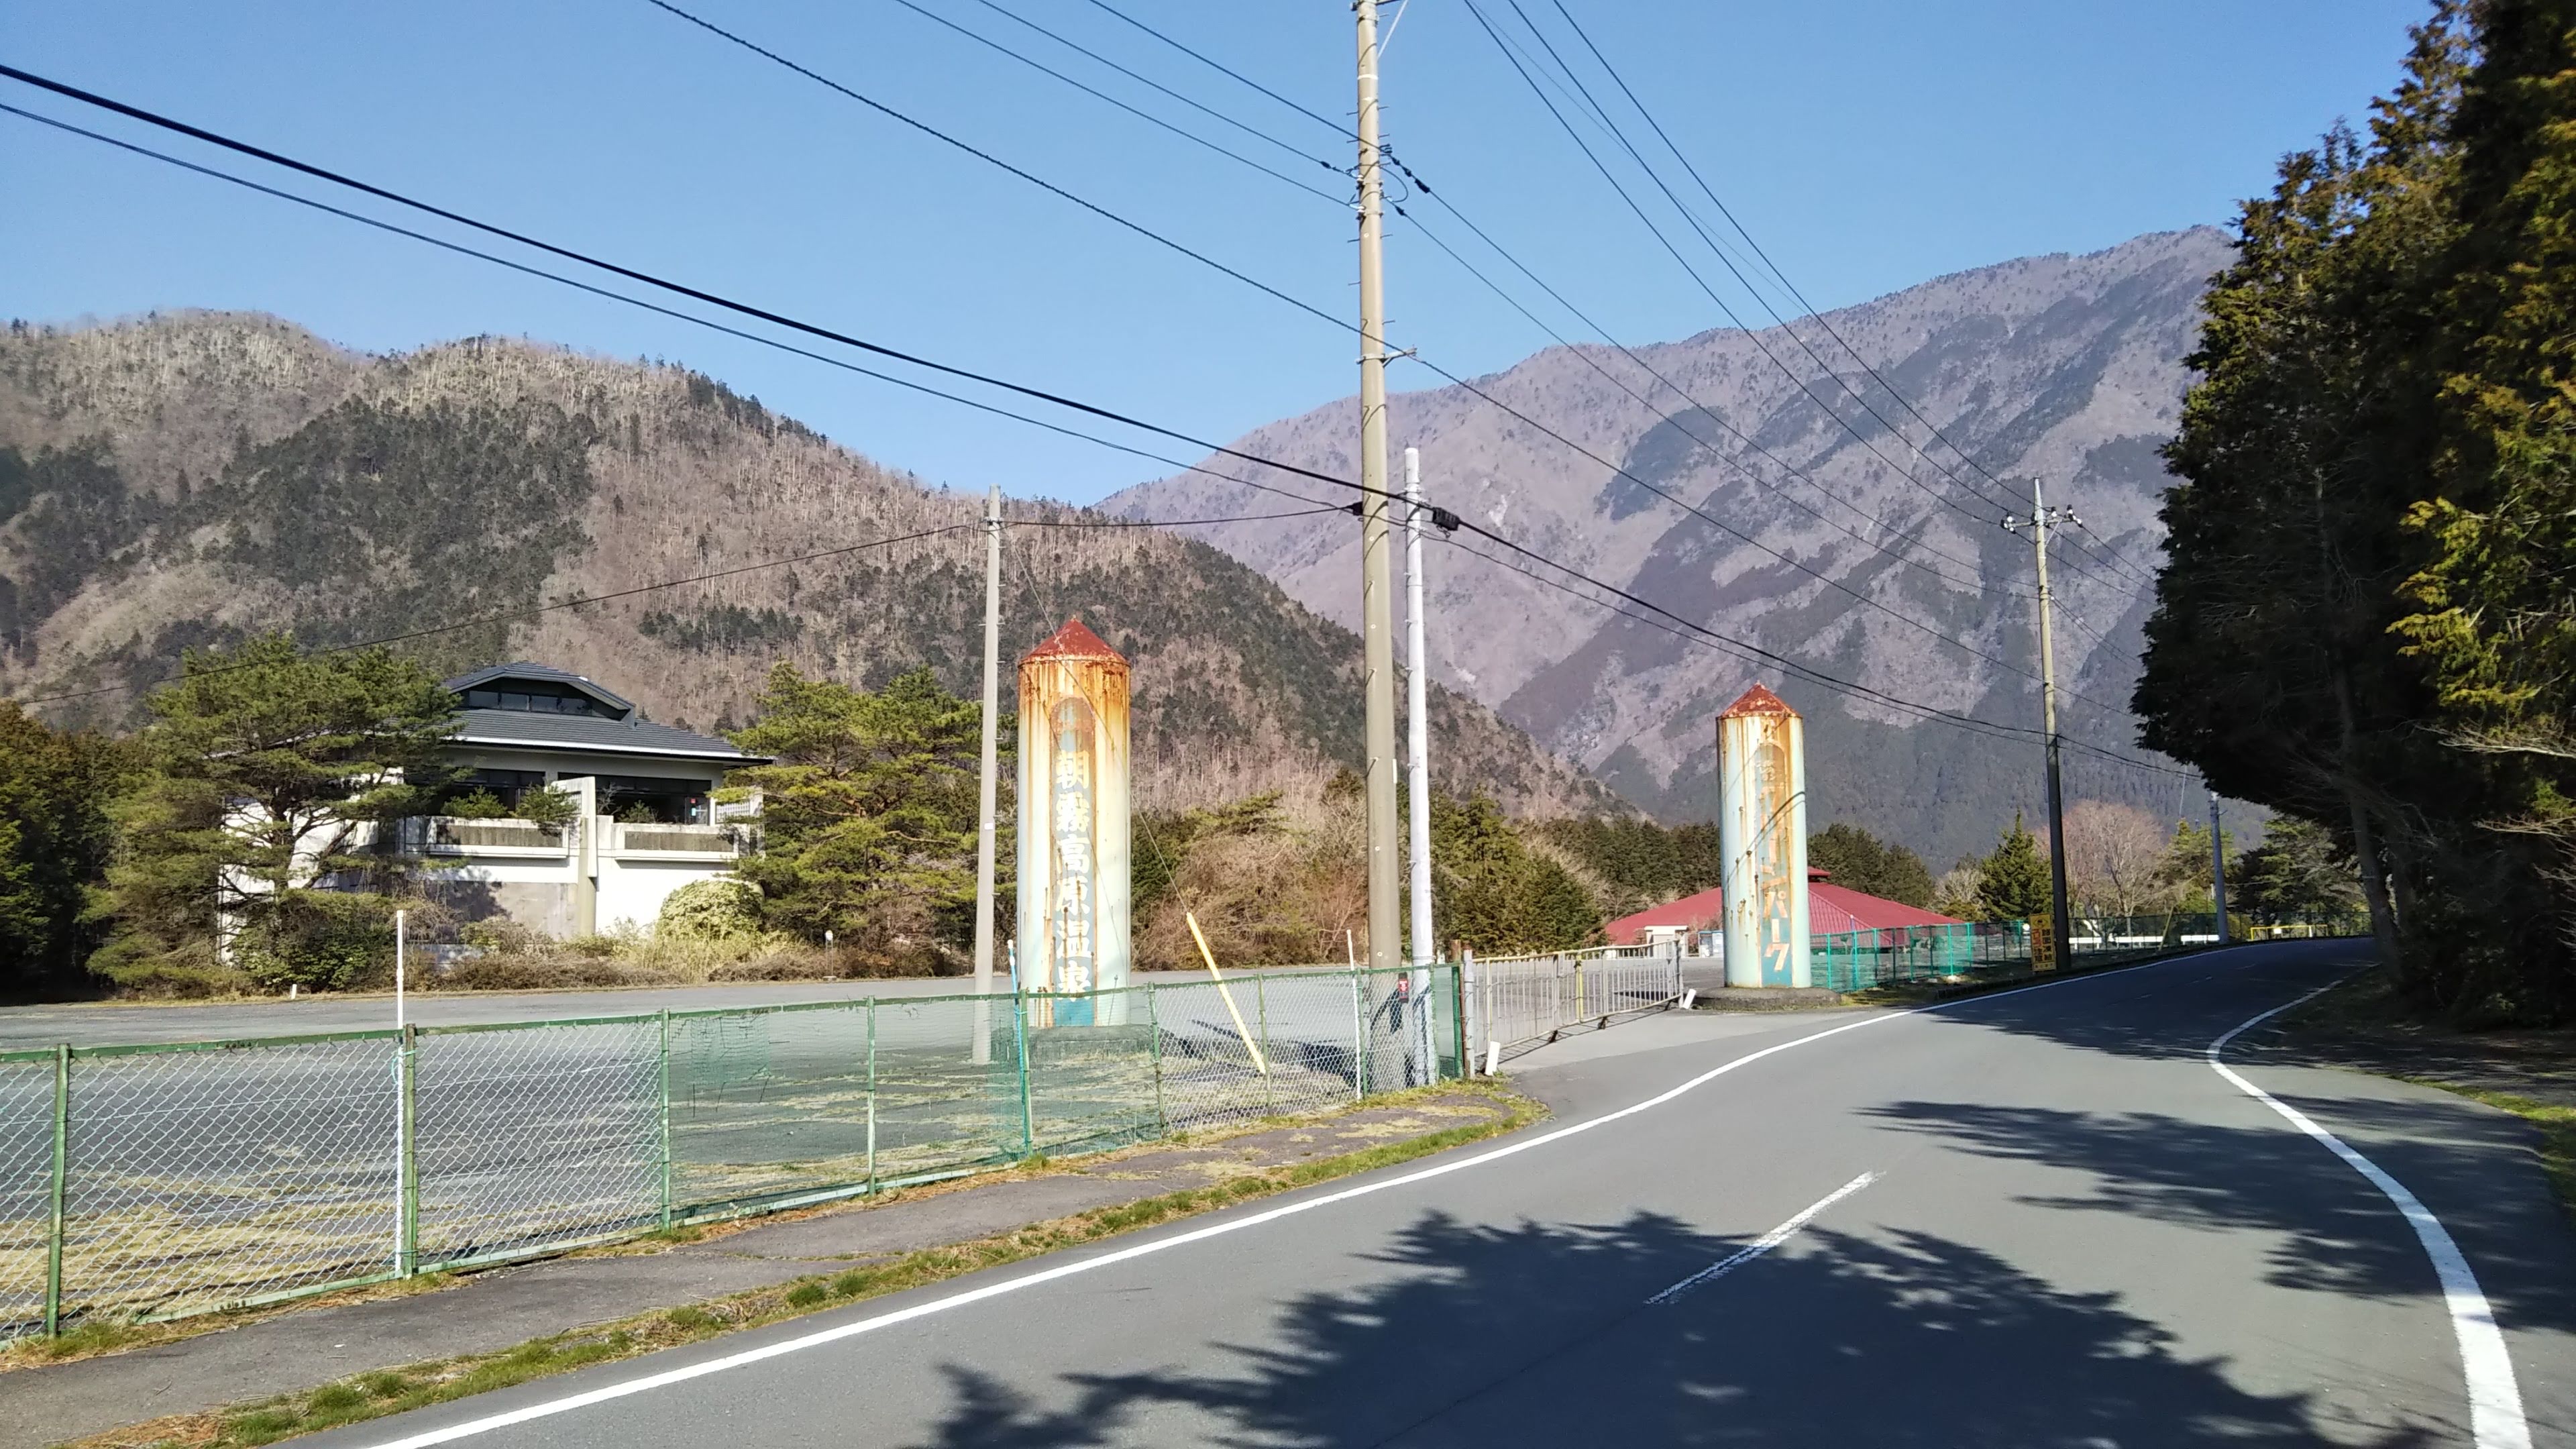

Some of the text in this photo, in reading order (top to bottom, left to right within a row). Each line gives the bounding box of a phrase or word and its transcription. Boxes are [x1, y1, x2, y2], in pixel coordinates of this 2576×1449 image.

[1057, 749, 1091, 1002] 朝霧高原温泉
